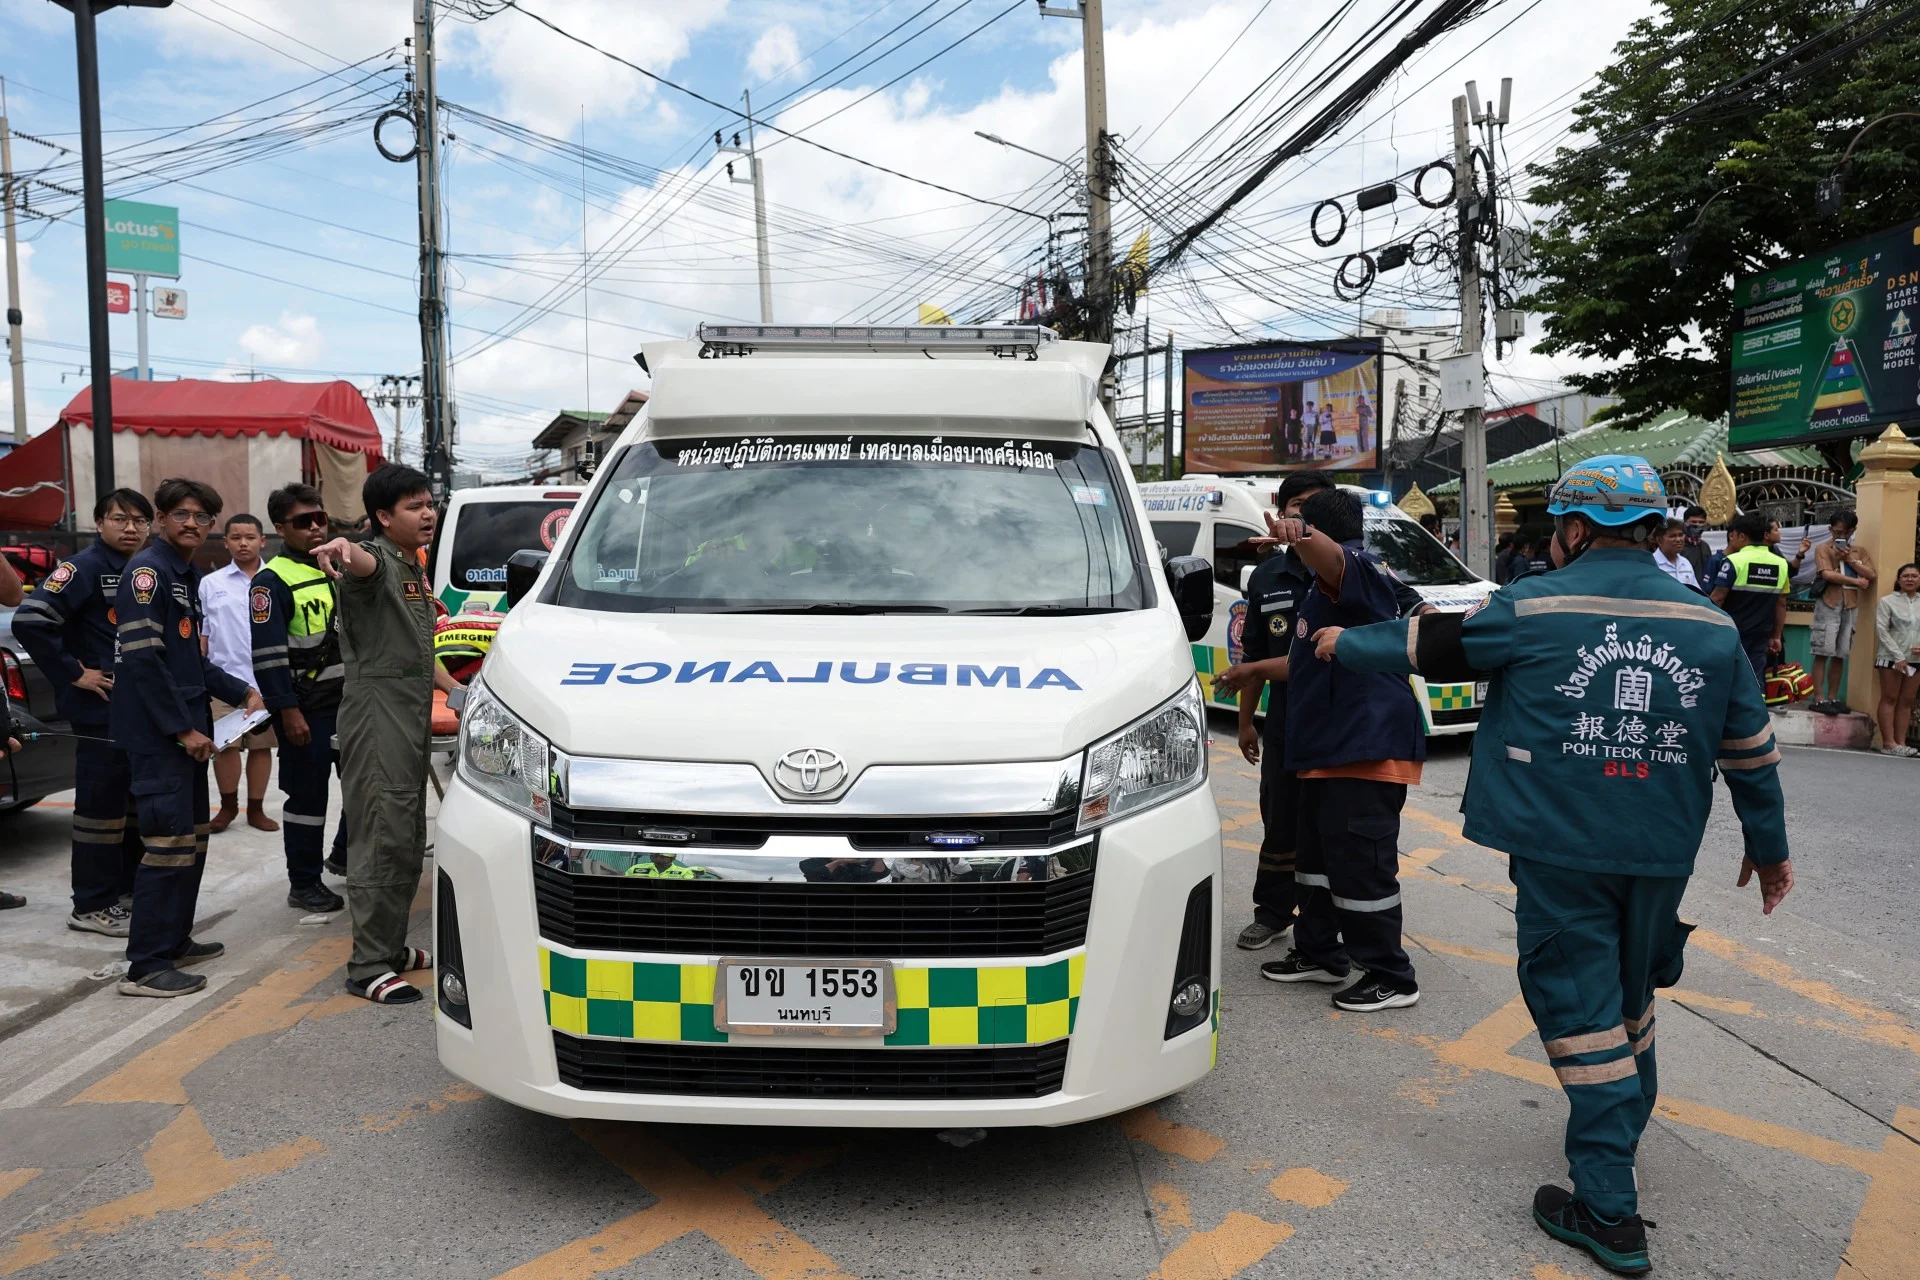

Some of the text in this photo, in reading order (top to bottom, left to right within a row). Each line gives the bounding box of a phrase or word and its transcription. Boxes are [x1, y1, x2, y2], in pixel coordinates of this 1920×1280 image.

[1887, 270, 1919, 290] DSN
[1886, 285, 1918, 301] STARS
[1886, 296, 1918, 311] MODEL
[1743, 327, 1801, 351] 2567-2569
[1883, 334, 1917, 351] HAPPY
[1839, 354, 1846, 362] H
[1883, 348, 1915, 361] SCHOOL
[1219, 358, 1336, 373] รางวัลยอดเยี่ยม อันดับ 1
[1771, 364, 1803, 380] (Vision)
[1839, 367, 1845, 375] A
[1883, 358, 1915, 370] MODEL
[1809, 414, 1870, 430] SCHOOL MODEL
[677, 435, 1054, 470] หน่วยปฏิบัติการแพทย์ เทศบาลเมืองบางศรีเมือง
[1568, 479, 1595, 487] RESCUE
[1177, 495, 1206, 511] 1418
[1629, 496, 1656, 504] PELICAN
[1757, 567, 1771, 575] EMR
[1570, 712, 1688, 749] 報德堂
[1562, 742, 1687, 764] POH TECK TUNG
[1604, 760, 1650, 779] BLS
[739, 967, 878, 998] ขข 1553
[777, 1006, 832, 1024] นนทบุรี
